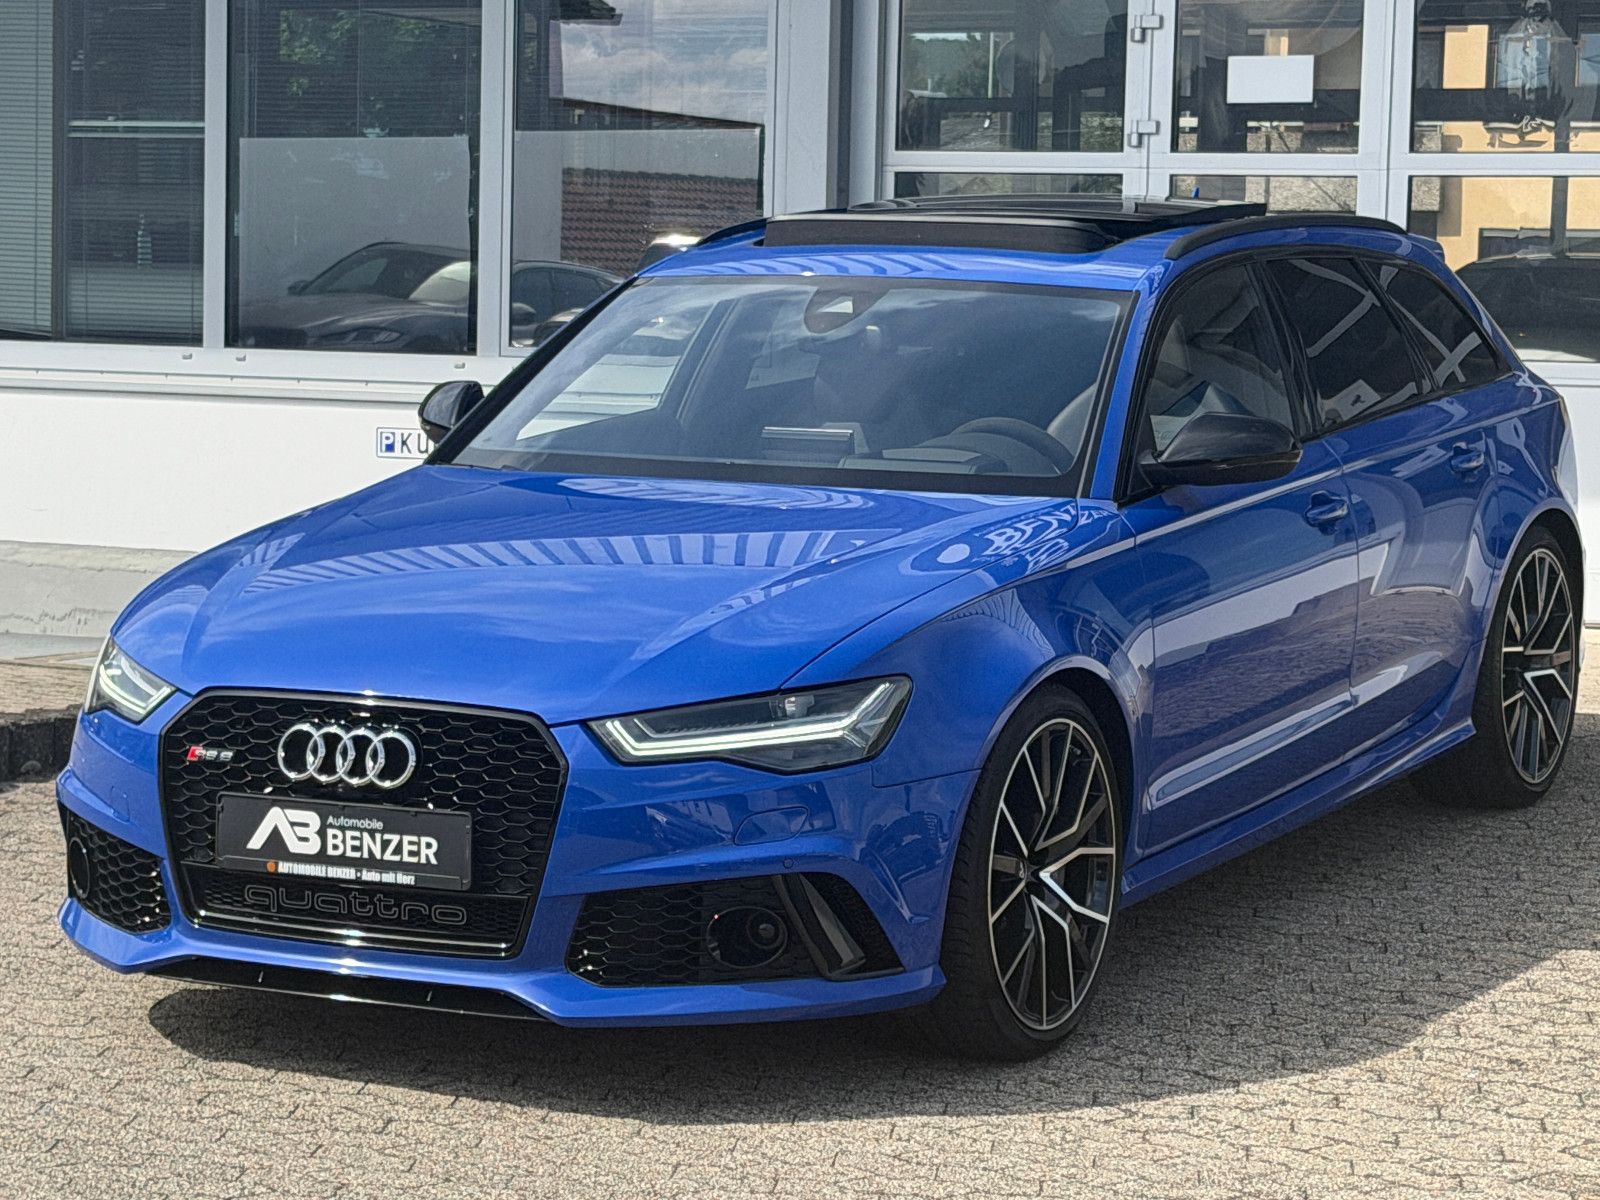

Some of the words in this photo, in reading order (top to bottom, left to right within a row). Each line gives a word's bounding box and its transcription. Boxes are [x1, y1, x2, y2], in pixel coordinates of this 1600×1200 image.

[381, 432, 395, 453] P
[246, 806, 321, 855] AB
[327, 815, 384, 830] Automobile
[326, 828, 438, 865] BENZER
[278, 861, 326, 877] AUTOMOBILE
[361, 868, 381, 882] Auto
[244, 885, 467, 925] quattro
